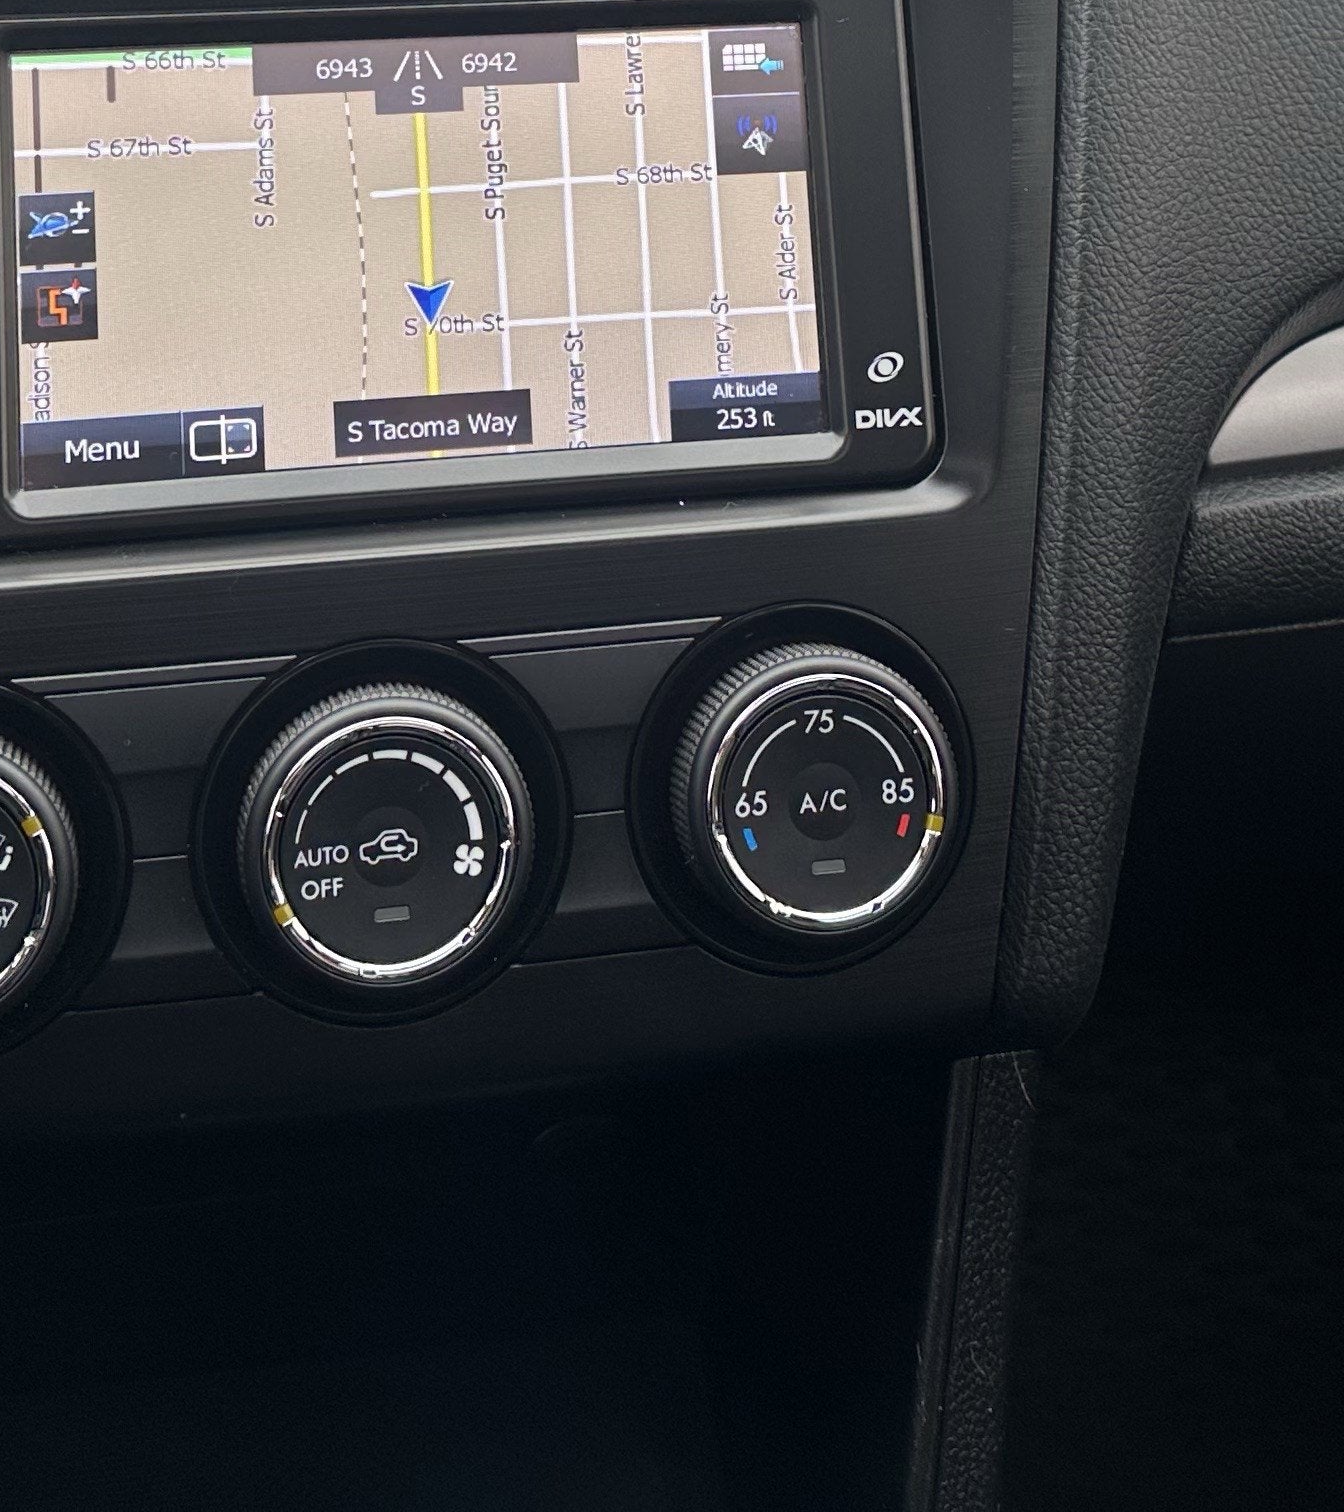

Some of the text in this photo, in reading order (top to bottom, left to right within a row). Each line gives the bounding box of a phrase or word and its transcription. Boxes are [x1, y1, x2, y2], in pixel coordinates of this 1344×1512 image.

[122, 50, 226, 70] S 66th St
[316, 57, 374, 80] 6943
[461, 52, 518, 74] 6942
[411, 85, 427, 106] S
[625, 102, 646, 116] S
[87, 136, 192, 158] S 67th St
[253, 108, 275, 227] S Adams St
[482, 139, 507, 200] Puget
[616, 163, 713, 185] S 68th St
[485, 207, 506, 220] S
[774, 204, 798, 301] S Alder St
[405, 318, 418, 336] S
[482, 314, 505, 332] St
[711, 293, 735, 376] mery St
[564, 330, 584, 352] St
[568, 359, 587, 433] Warner
[712, 381, 778, 399] Altitude
[348, 412, 517, 442] S Tacoma Way
[717, 407, 776, 430] 253 ft
[65, 439, 140, 463] Menu
[804, 709, 834, 734] 75
[799, 789, 847, 814] A/C
[882, 777, 915, 805] 85
[735, 790, 768, 818] 65
[294, 845, 349, 869] AUTO
[301, 877, 344, 900] OFF
